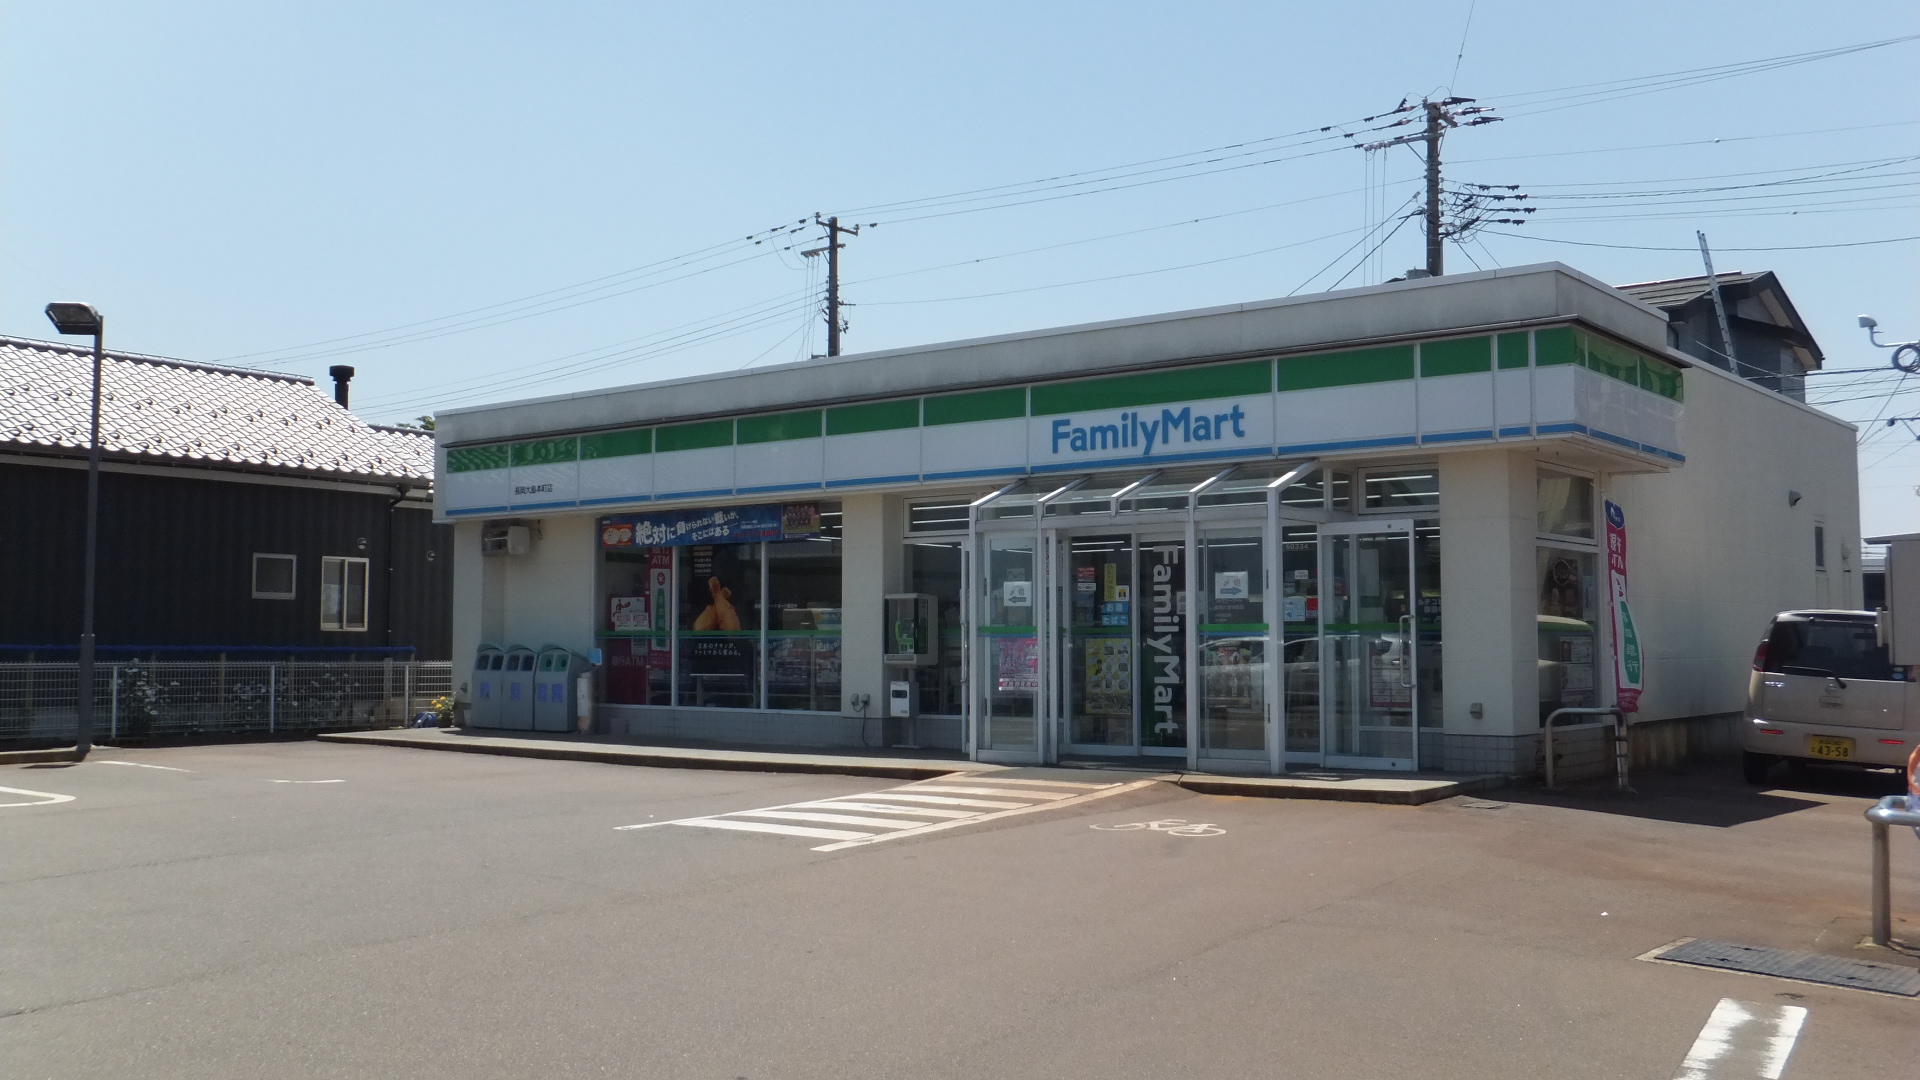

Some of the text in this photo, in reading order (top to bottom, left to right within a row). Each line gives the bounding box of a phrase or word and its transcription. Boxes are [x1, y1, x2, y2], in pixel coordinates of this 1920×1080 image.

[1052, 404, 1245, 455] FamilyMart
[692, 525, 730, 541] そこにはある
[652, 555, 670, 565] ATM
[1103, 616, 1127, 625] たばこ
[1147, 545, 1180, 734] FamilyMart
[1817, 745, 1848, 757] 43-58
